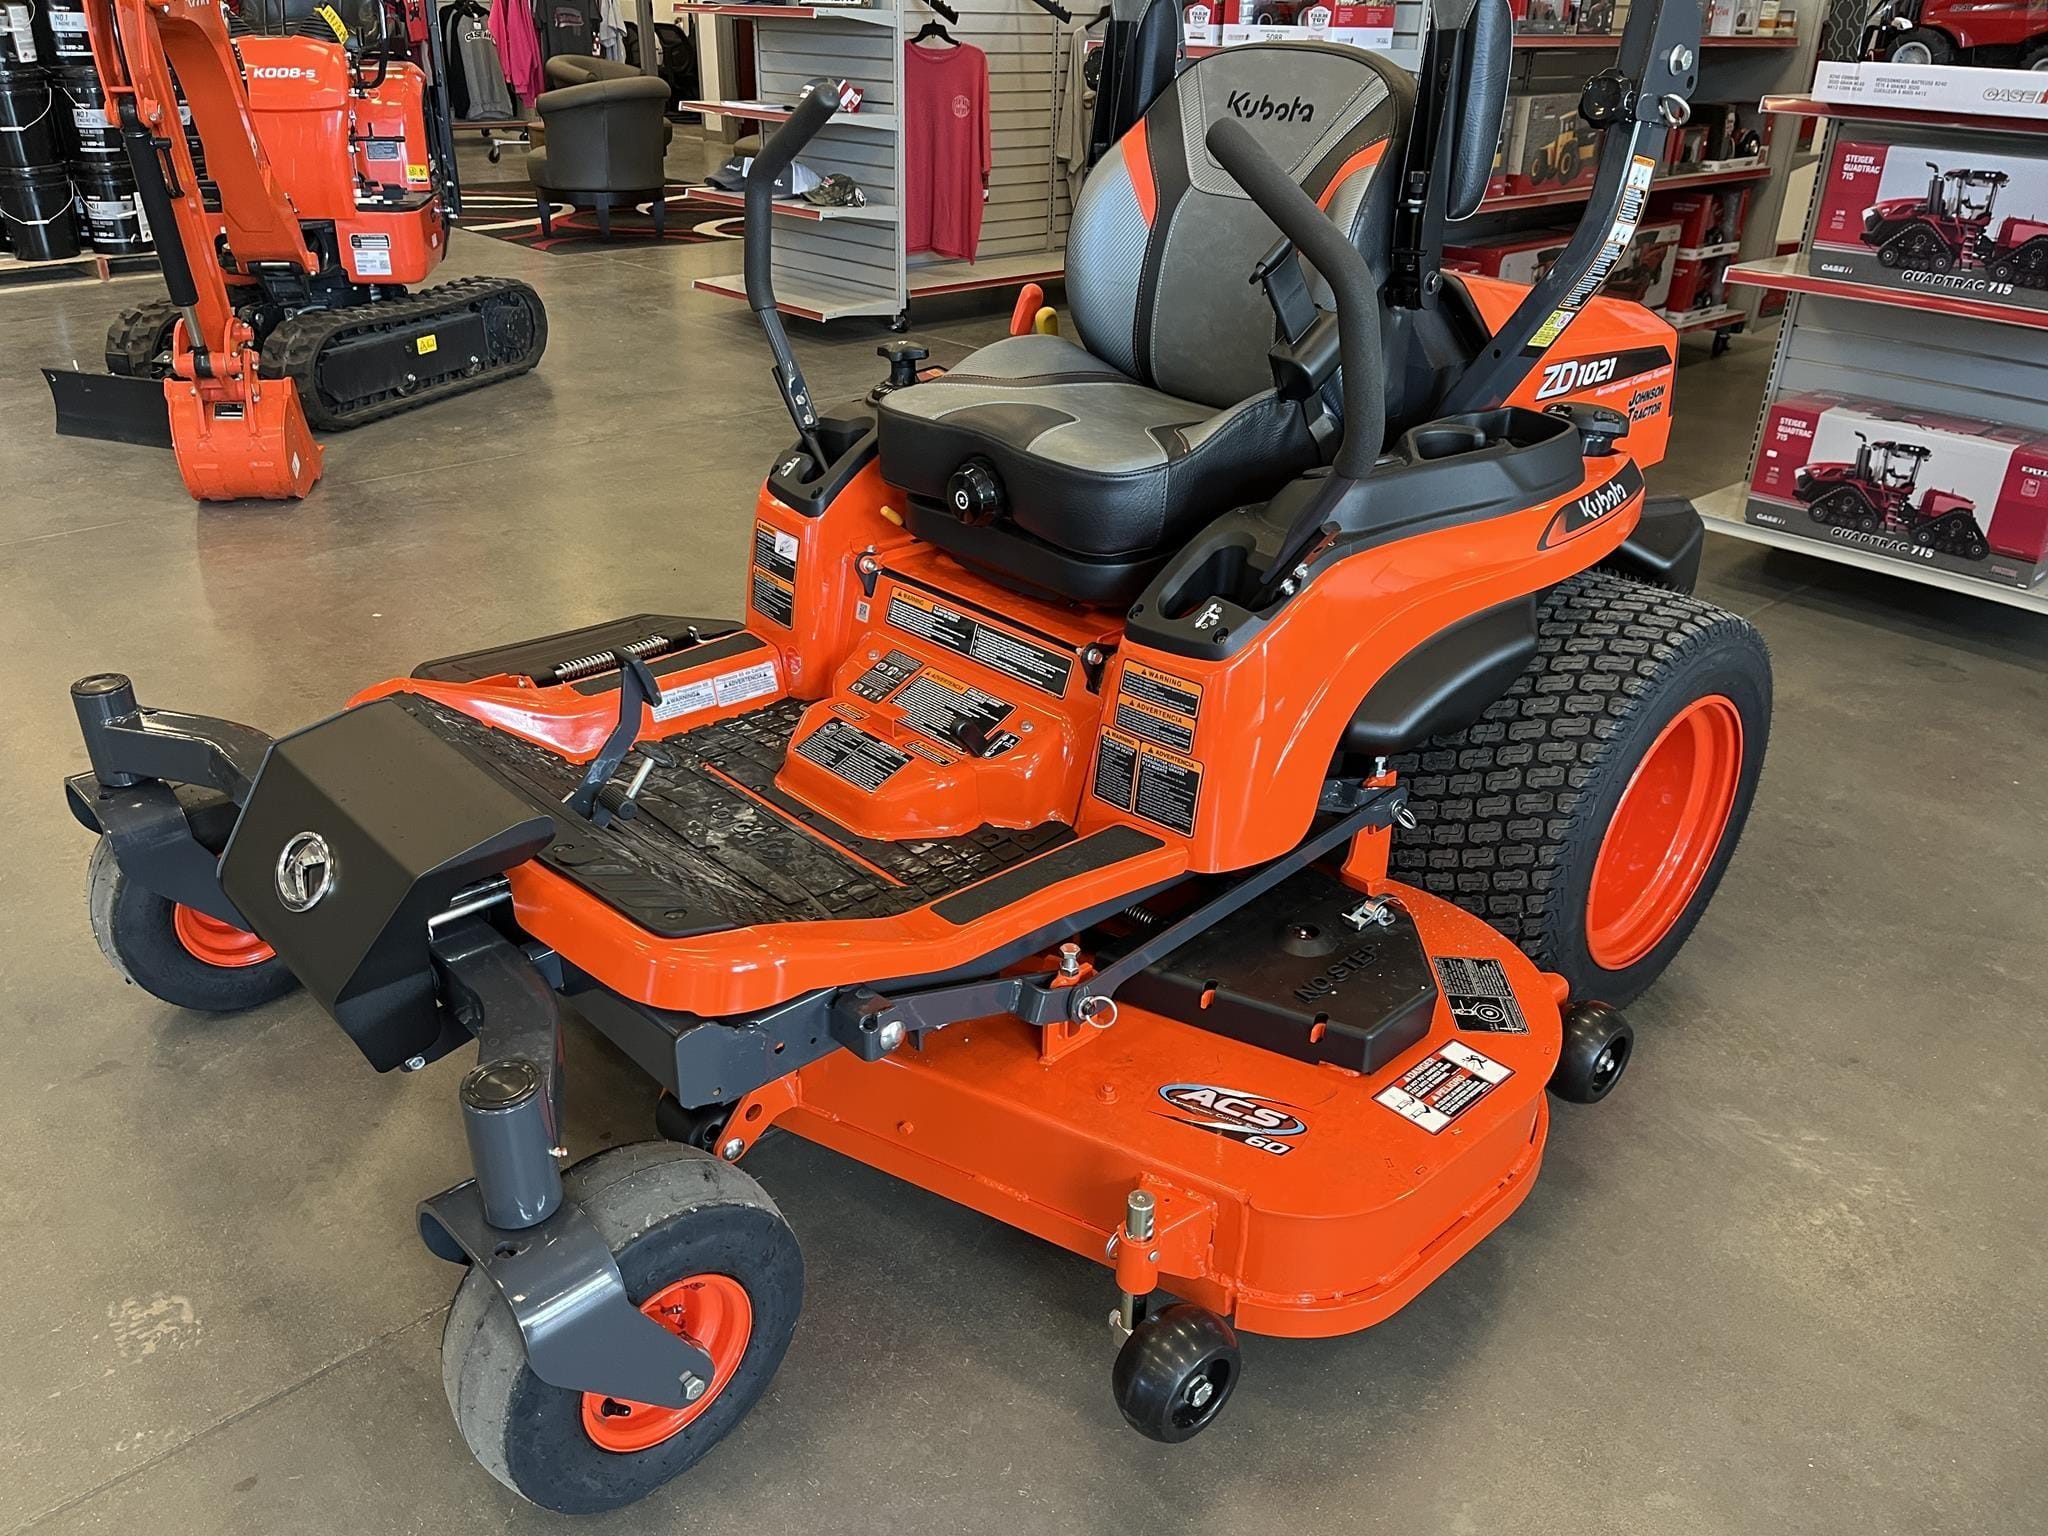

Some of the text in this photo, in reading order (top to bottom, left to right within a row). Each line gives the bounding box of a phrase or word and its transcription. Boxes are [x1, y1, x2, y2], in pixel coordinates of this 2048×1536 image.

[1983, 88, 2036, 103] CASE
[1226, 90, 1315, 122] Kubota
[1843, 163, 1881, 174] QUADTRAC
[1845, 154, 1875, 164] STEIGER
[1842, 172, 1854, 180] 715
[1901, 269, 2014, 295] QUADTRAC 715
[1535, 357, 1618, 401] ZD1021
[1628, 384, 1666, 407] JOHNSON
[1628, 402, 1662, 424] TRACTOR
[1777, 424, 1814, 438] QUADTRAC
[1780, 417, 1808, 429] STEIGER
[1776, 432, 1788, 441] 715
[1578, 481, 1628, 519] Kubota
[1830, 526, 1935, 559] QUADTRAC 715
[728, 673, 763, 687] ADVERTENCIA
[1149, 669, 1182, 687] WARNING
[670, 693, 697, 703] WARNING
[1136, 702, 1183, 723] ADVERTENCIA
[1111, 732, 1135, 746] WARNING
[1155, 750, 1195, 768] ADVERTENCIA
[1293, 944, 1380, 1004] NO STEP
[1408, 1057, 1437, 1081] DANGER
[1436, 1074, 1466, 1098] PELIGRO
[1175, 1088, 1289, 1128] ACS
[1244, 1135, 1290, 1154] 60
